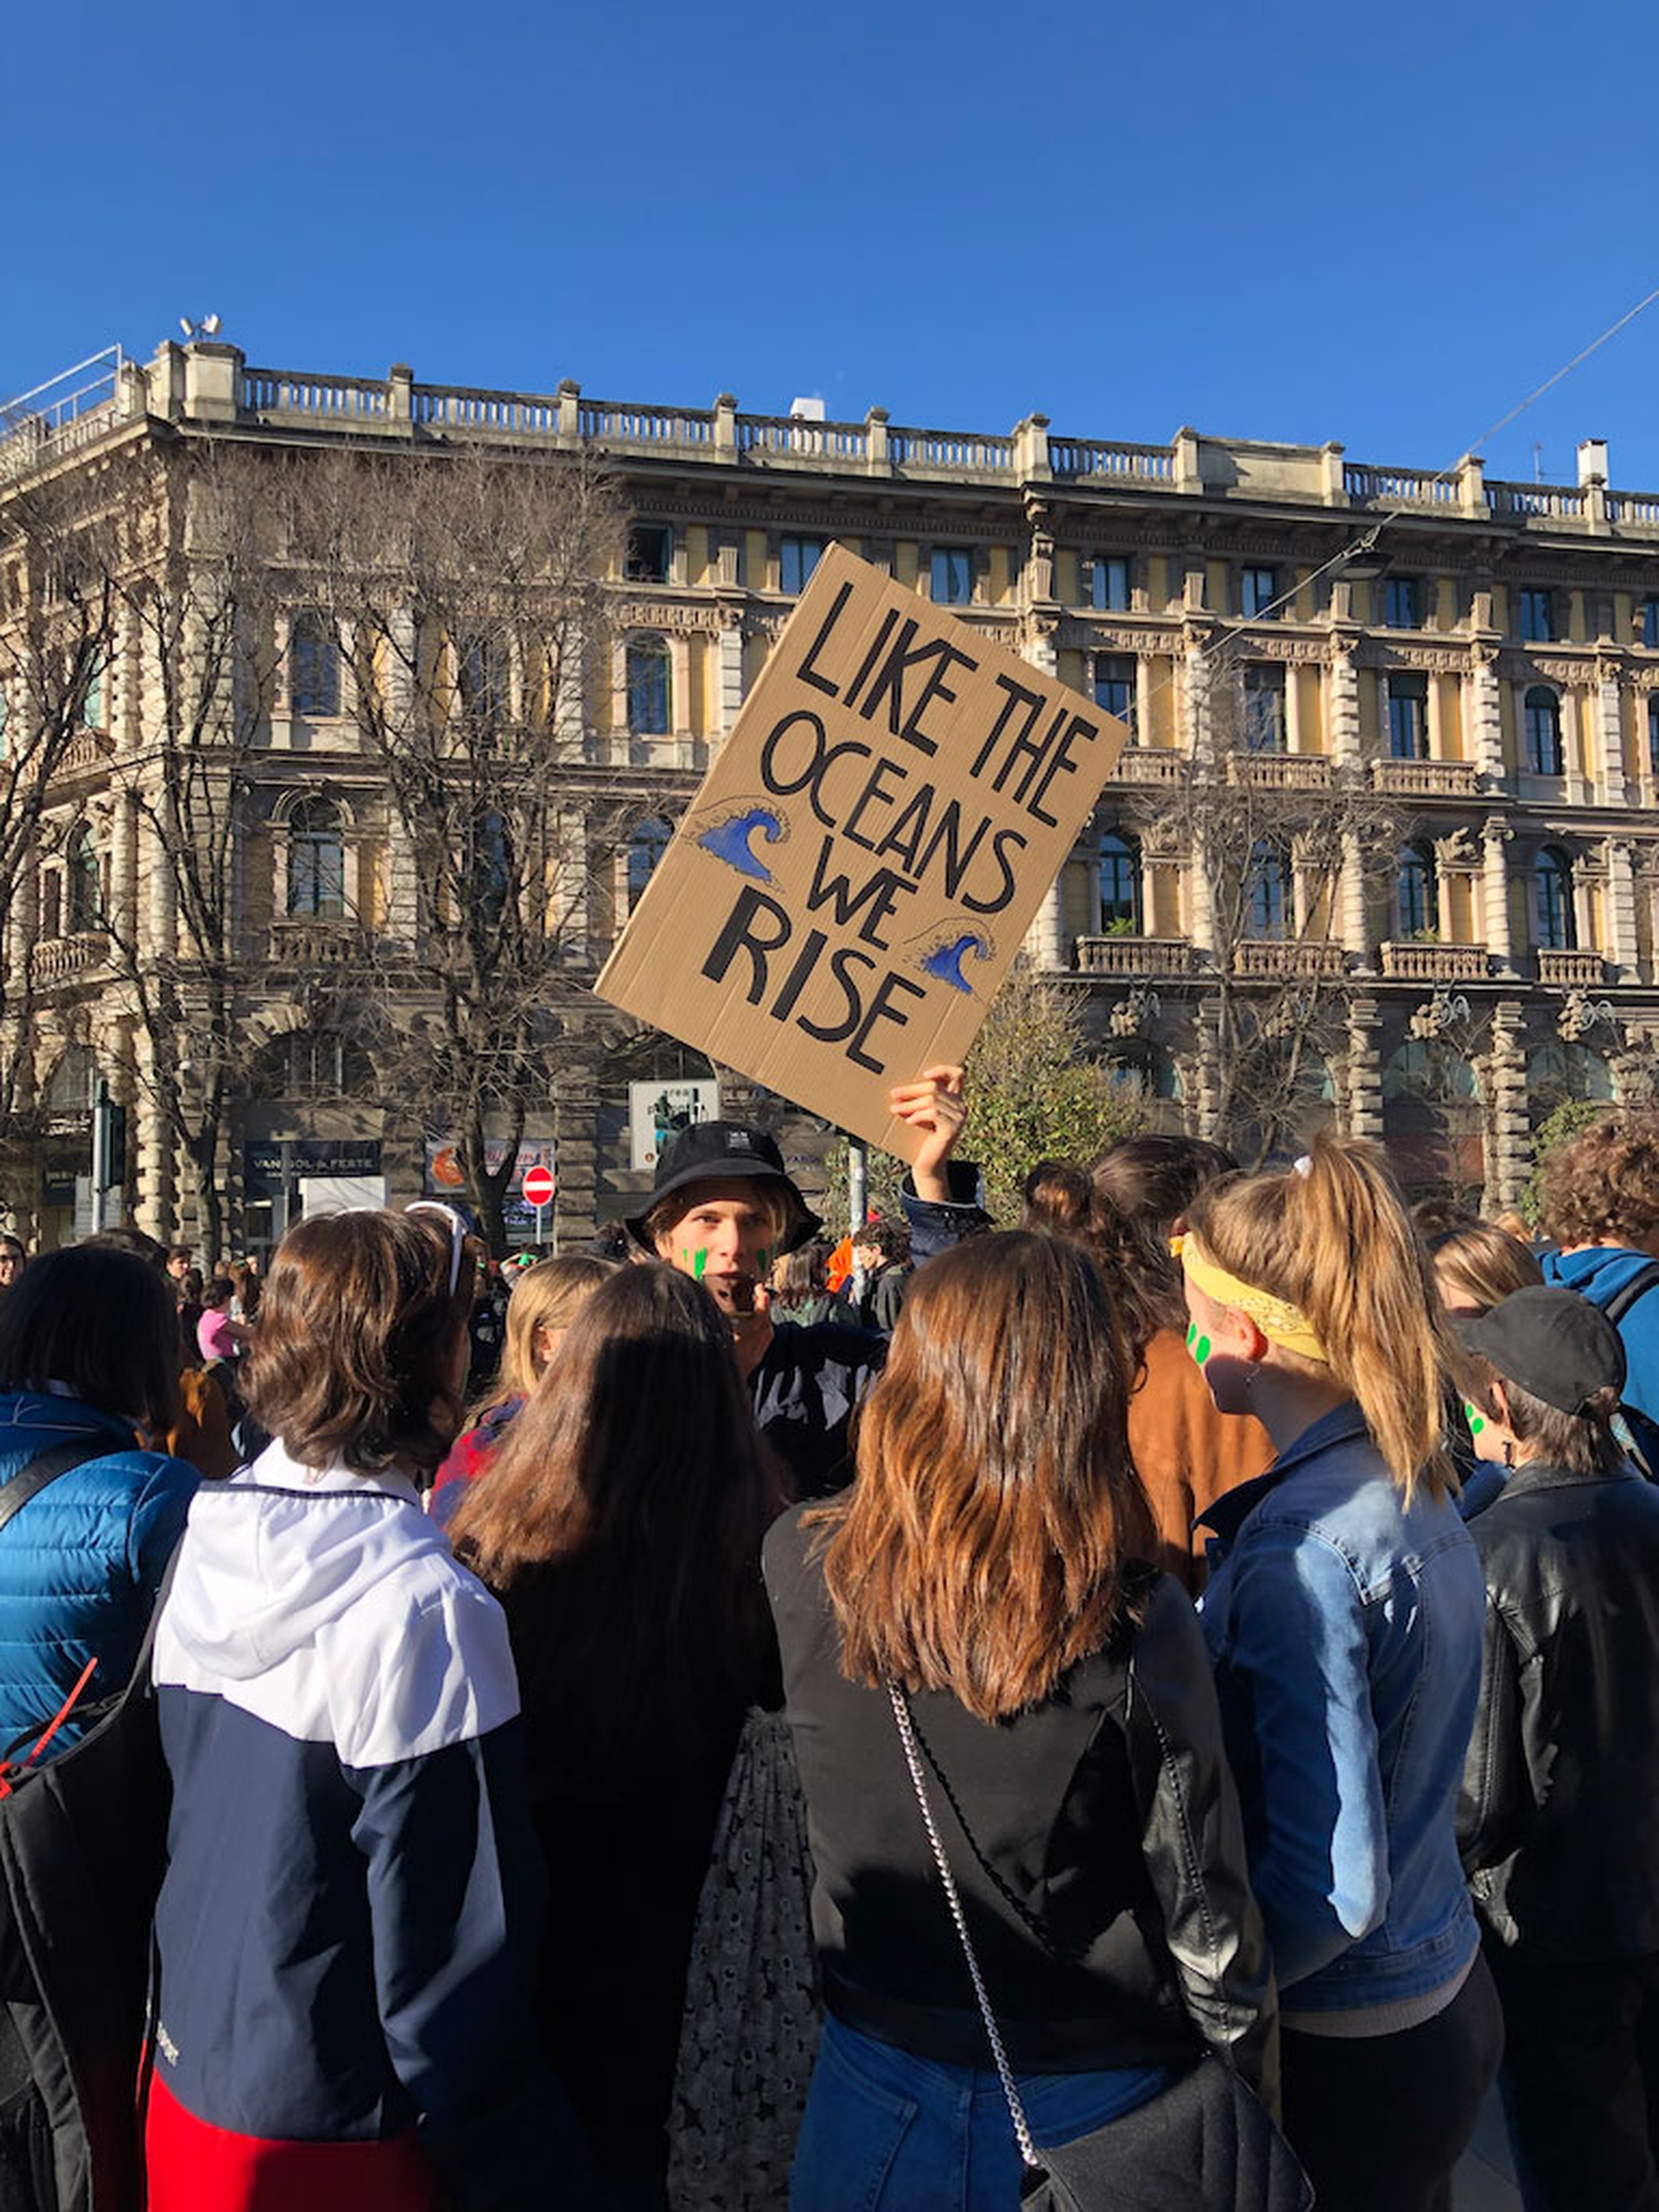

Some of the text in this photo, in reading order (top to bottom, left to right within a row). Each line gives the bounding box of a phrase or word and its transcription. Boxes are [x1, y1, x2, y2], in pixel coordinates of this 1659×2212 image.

[797, 582, 1098, 828] LIKE THE
[761, 710, 1027, 913] OCEANS
[807, 836, 918, 950] WE
[702, 885, 926, 1074] RISE
